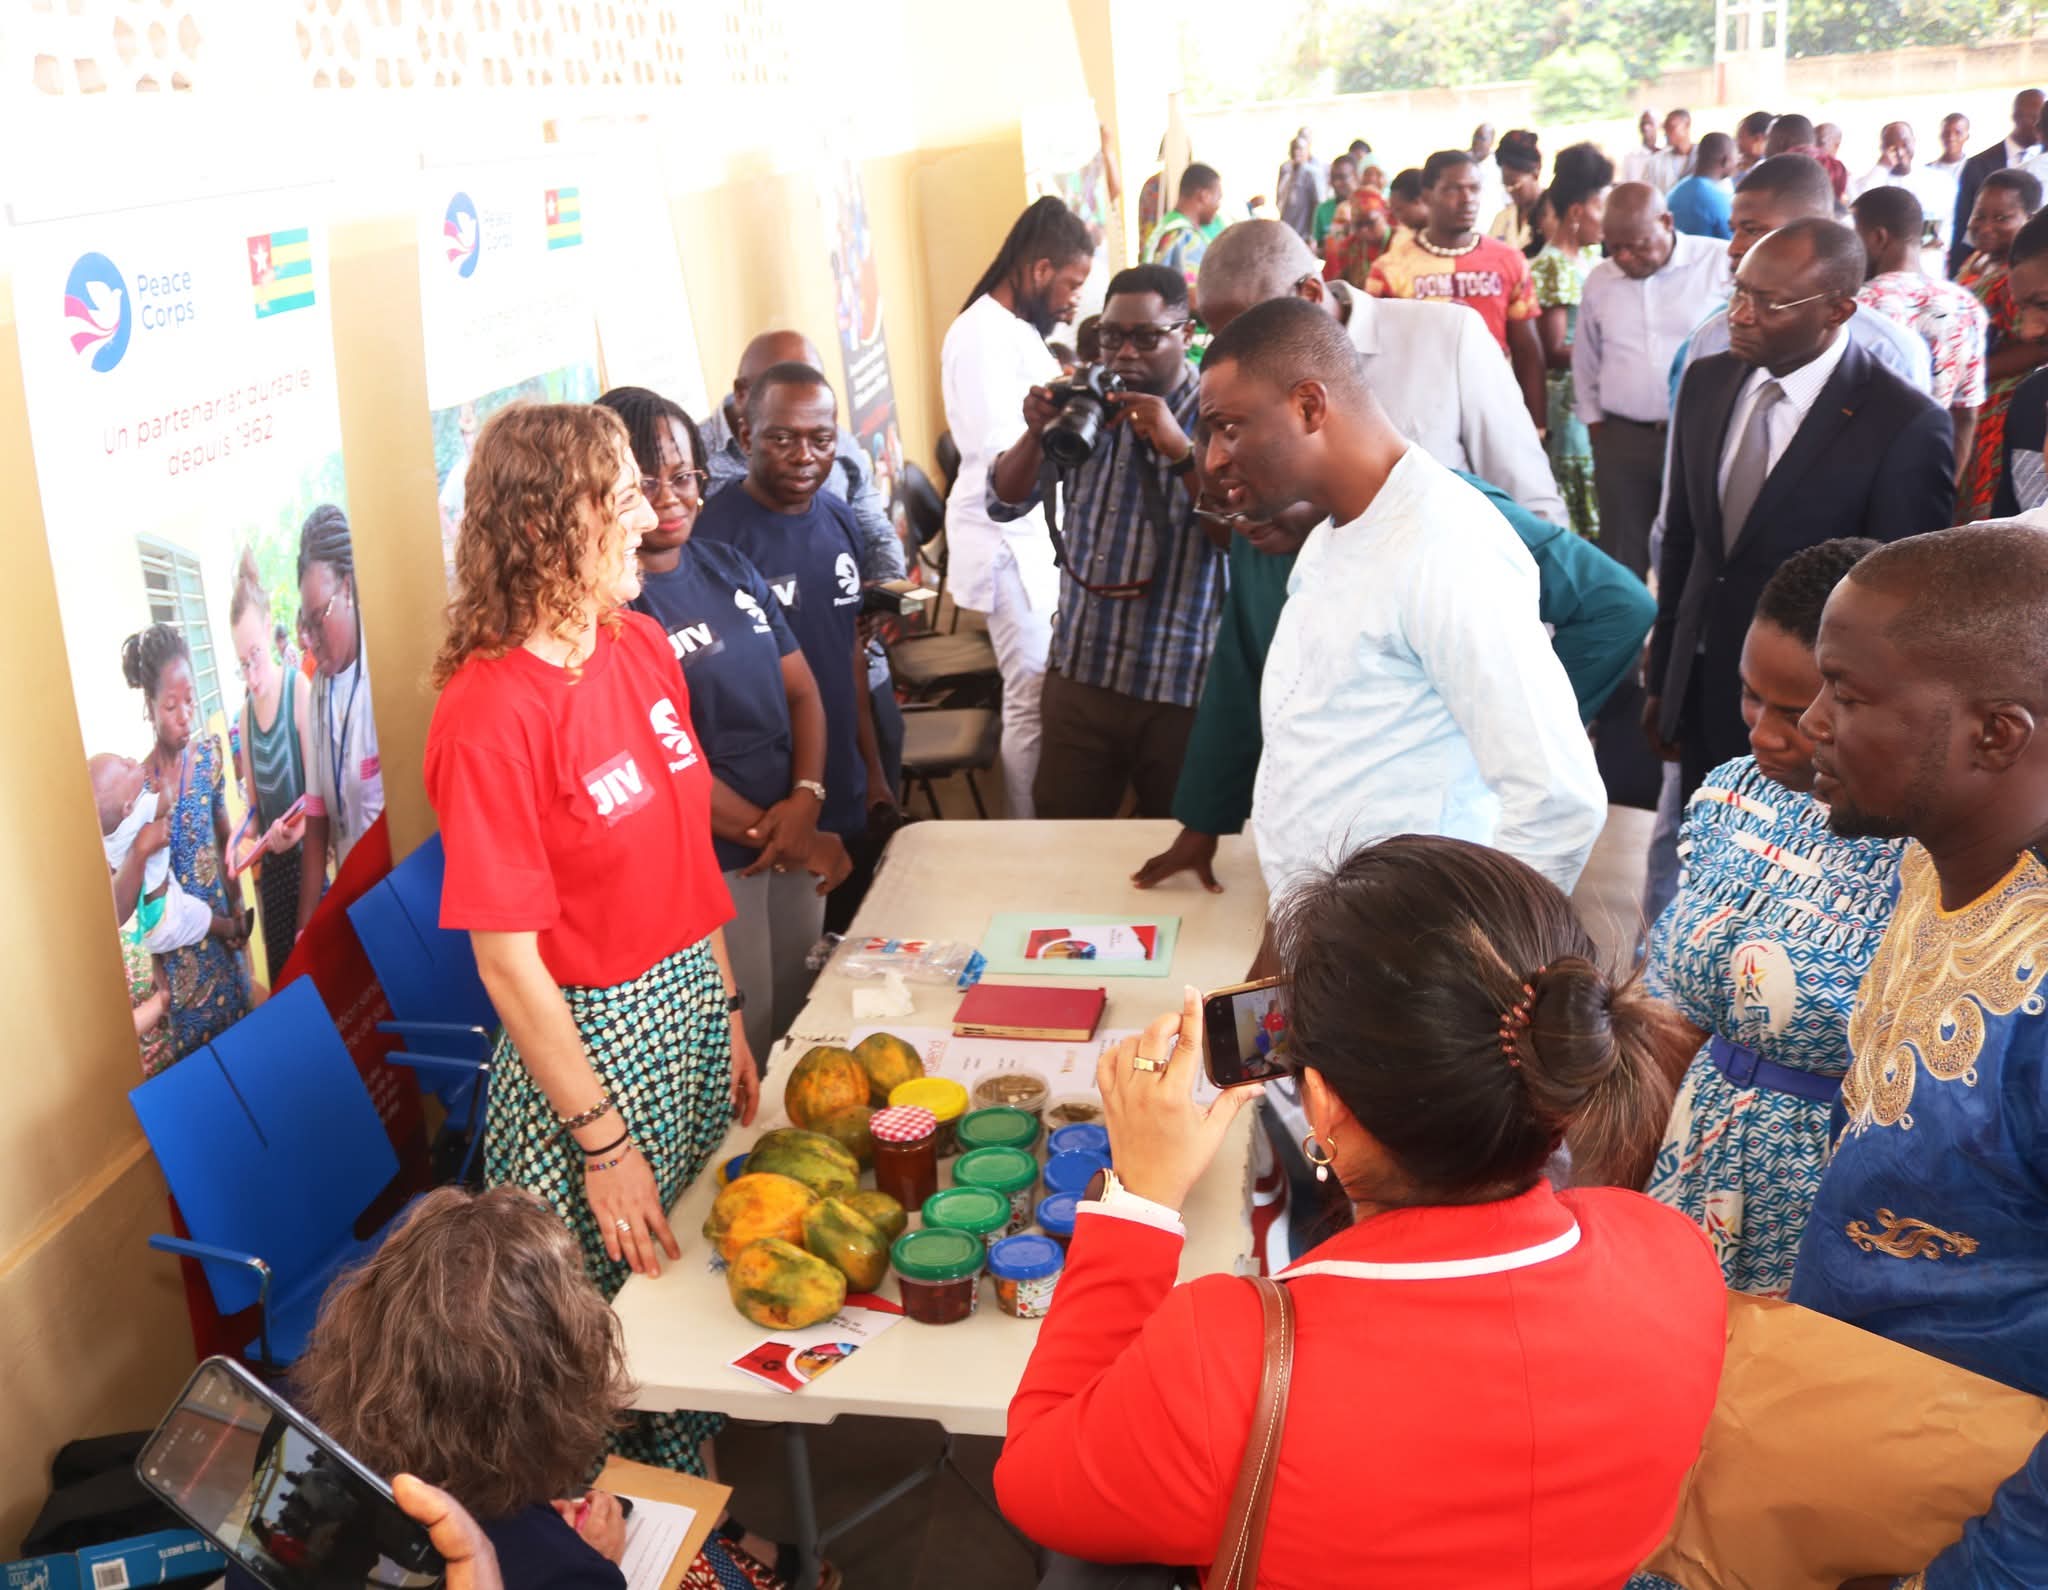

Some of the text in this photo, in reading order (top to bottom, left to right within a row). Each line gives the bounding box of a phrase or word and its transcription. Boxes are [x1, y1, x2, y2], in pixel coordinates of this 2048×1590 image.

[137, 270, 192, 299] Peace
[1455, 271, 1503, 298] TOGO
[141, 300, 195, 330] Corps
[103, 426, 128, 455] Un
[137, 387, 241, 446] partenariat
[168, 436, 231, 477] depuis
[586, 758, 644, 817] JIV
